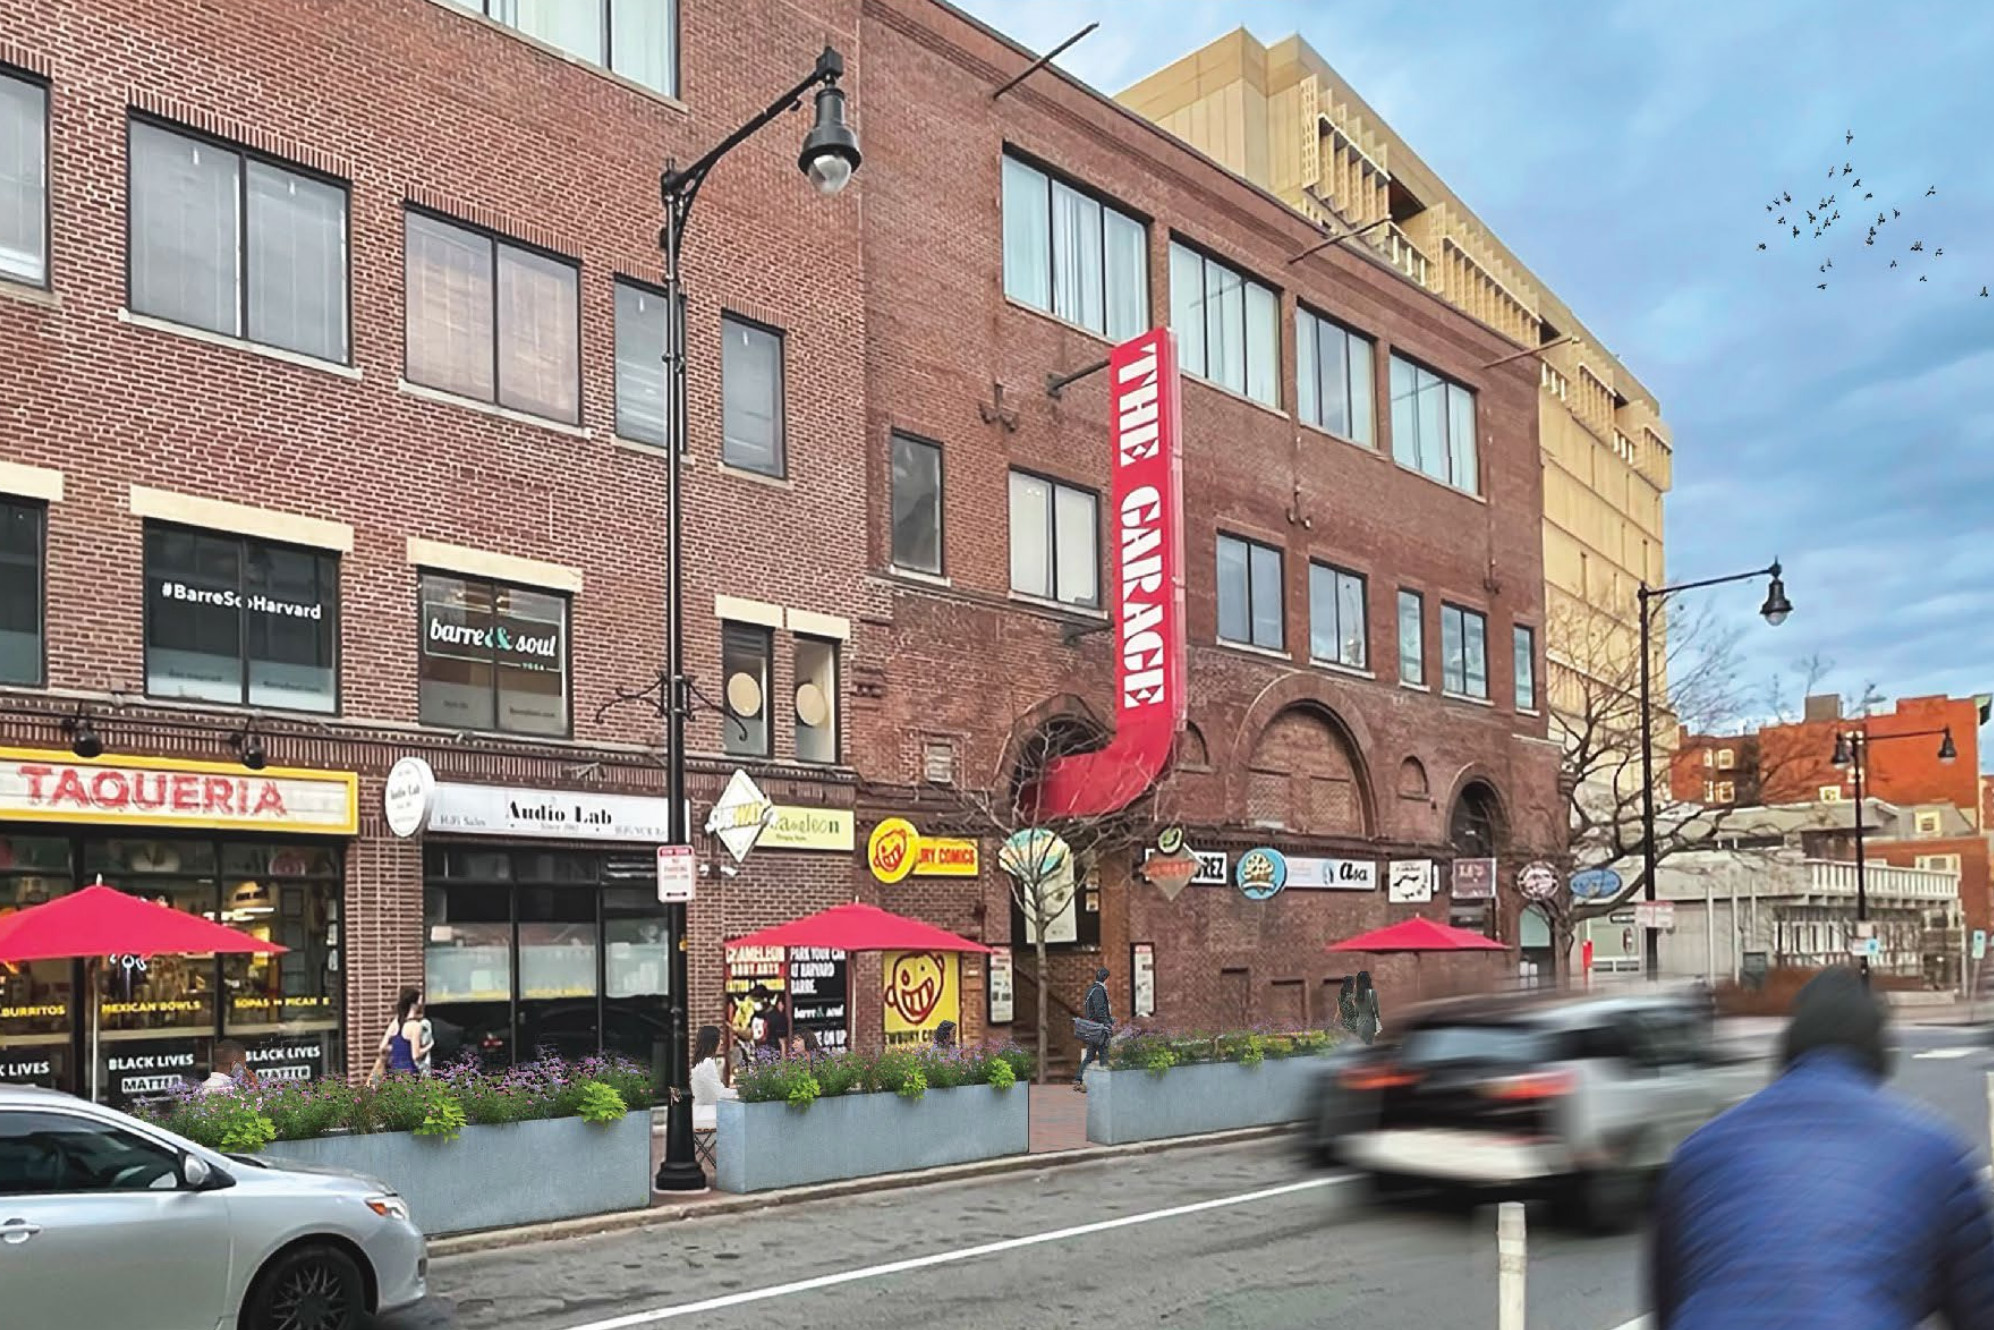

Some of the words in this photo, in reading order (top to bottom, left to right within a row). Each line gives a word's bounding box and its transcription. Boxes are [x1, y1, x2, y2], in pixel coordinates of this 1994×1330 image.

[1118, 342, 1159, 467] THE
[1121, 485, 1164, 708] GARAGE
[430, 618, 484, 645] barre
[516, 635, 557, 657] soul
[17, 764, 288, 816] TAQUERIA
[510, 801, 566, 822] Audio
[575, 805, 613, 825] Lab
[102, 1002, 156, 1014] MEXICAN
[160, 1000, 201, 1011] BOWLS
[109, 1056, 154, 1070] BLACK
[157, 1053, 194, 1067] LIVES
[246, 1048, 285, 1061] BLACK
[287, 1045, 321, 1059] LIVES
[9, 1061, 50, 1077] LIVES
